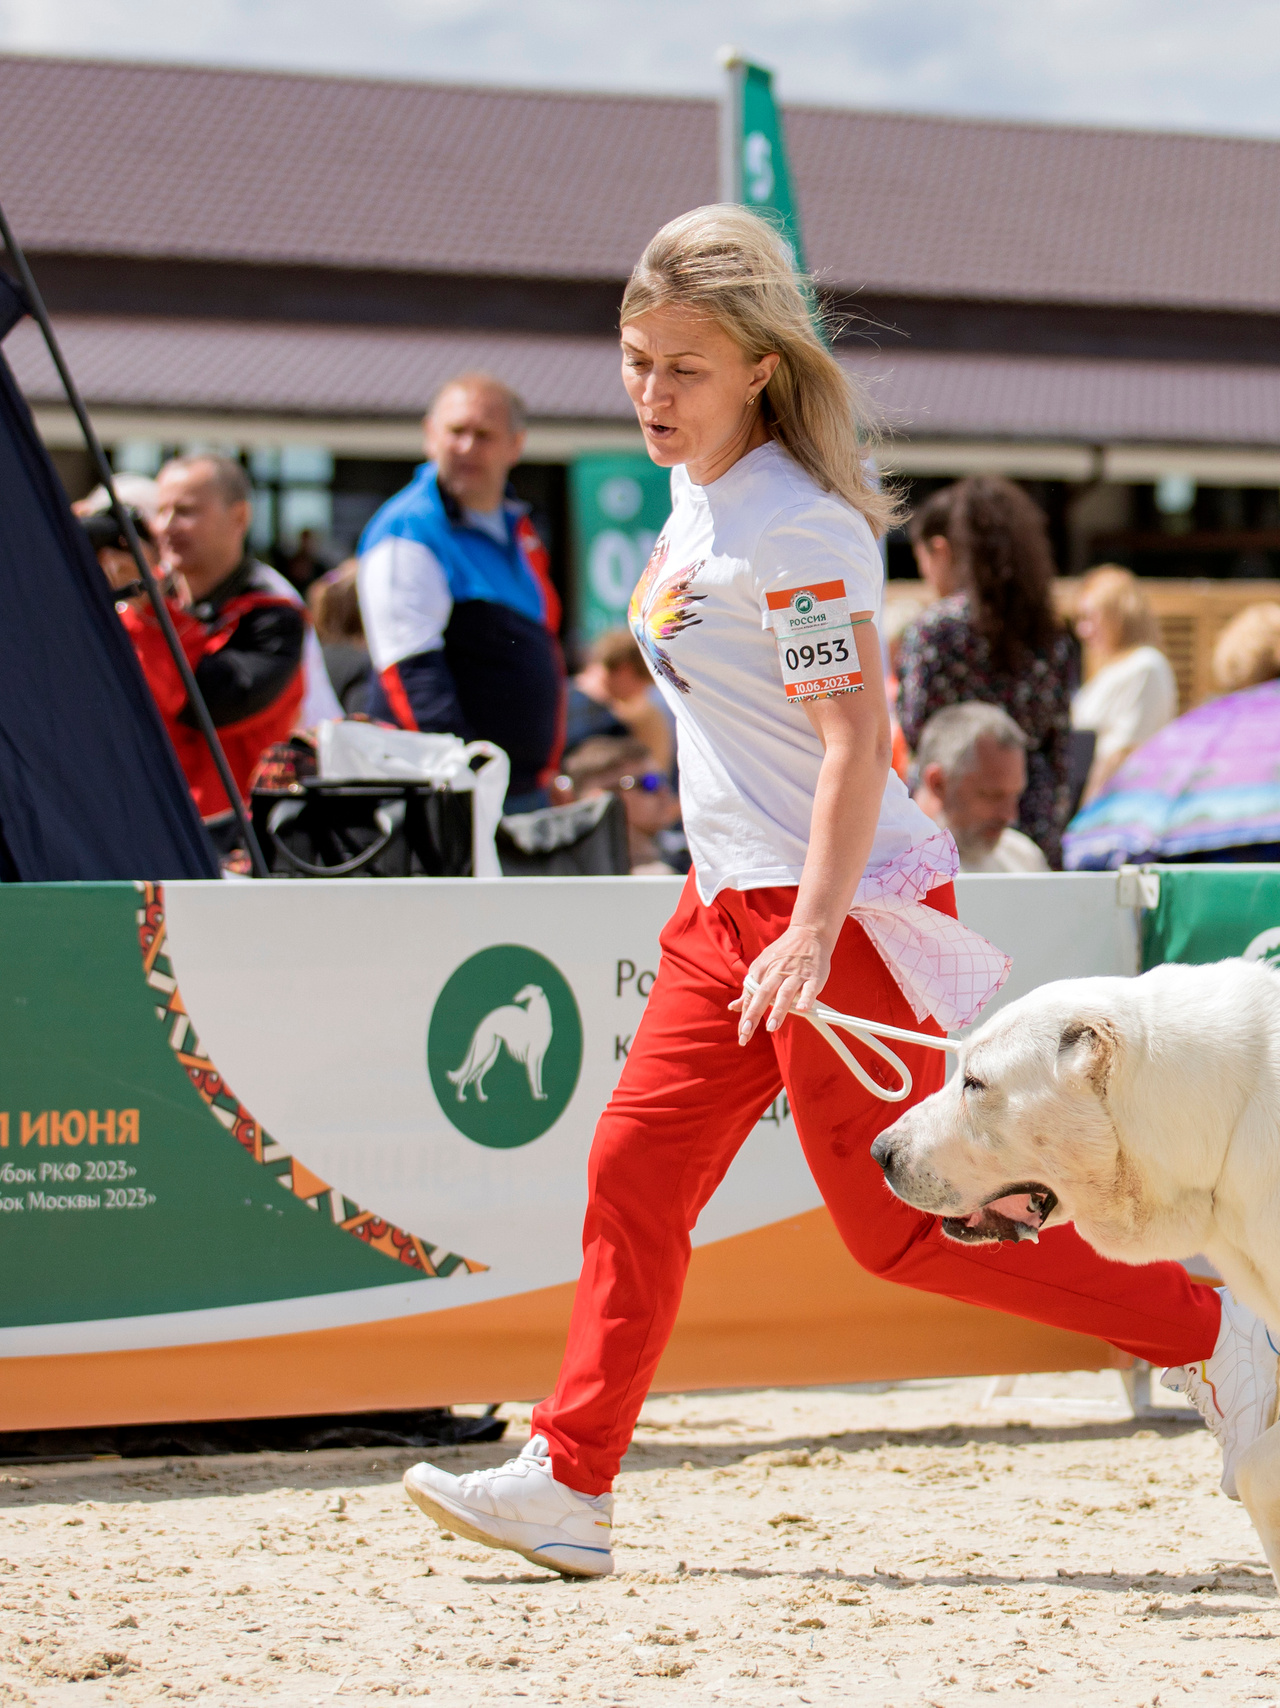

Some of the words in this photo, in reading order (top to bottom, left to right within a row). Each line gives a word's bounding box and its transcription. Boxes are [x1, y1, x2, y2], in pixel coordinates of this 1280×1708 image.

[789, 613, 827, 627] РОССИЯ
[785, 638, 849, 671] 0953
[794, 675, 850, 695] 10.06.2023
[20, 1108, 140, 1147] ИЮНЯ
[0, 1162, 36, 1184] бок
[39, 1161, 81, 1182] РКФ
[84, 1160, 137, 1181] 2023»
[27, 1190, 100, 1210] Москвы
[103, 1188, 157, 1209] 2023»
